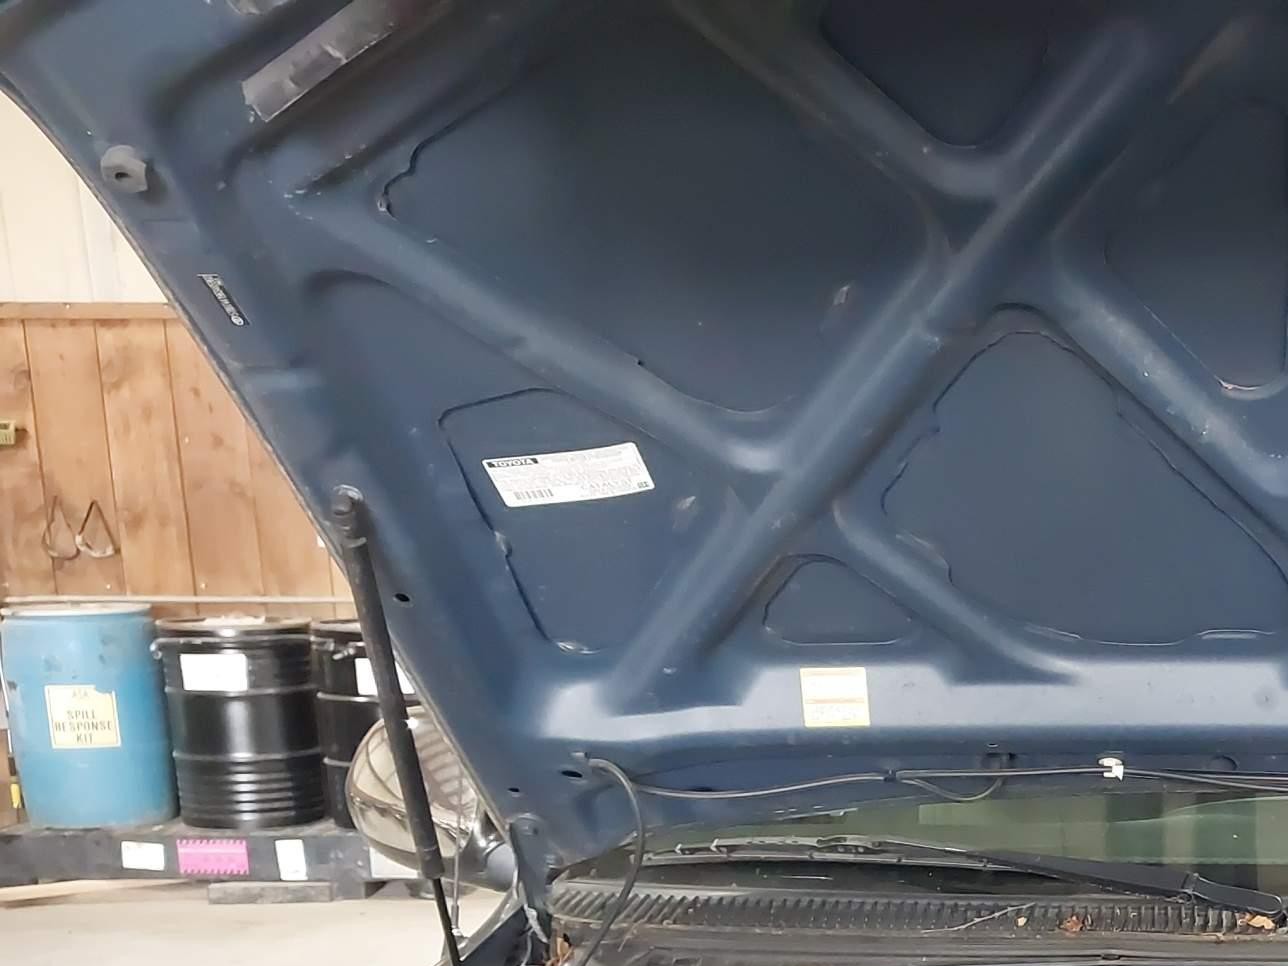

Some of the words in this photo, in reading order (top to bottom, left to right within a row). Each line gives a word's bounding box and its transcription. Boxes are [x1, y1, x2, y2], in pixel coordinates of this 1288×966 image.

[492, 458, 534, 468] TOYOTA
[66, 709, 96, 720] SPILL
[55, 720, 112, 732] RESPONSE
[76, 732, 94, 745] KIT
